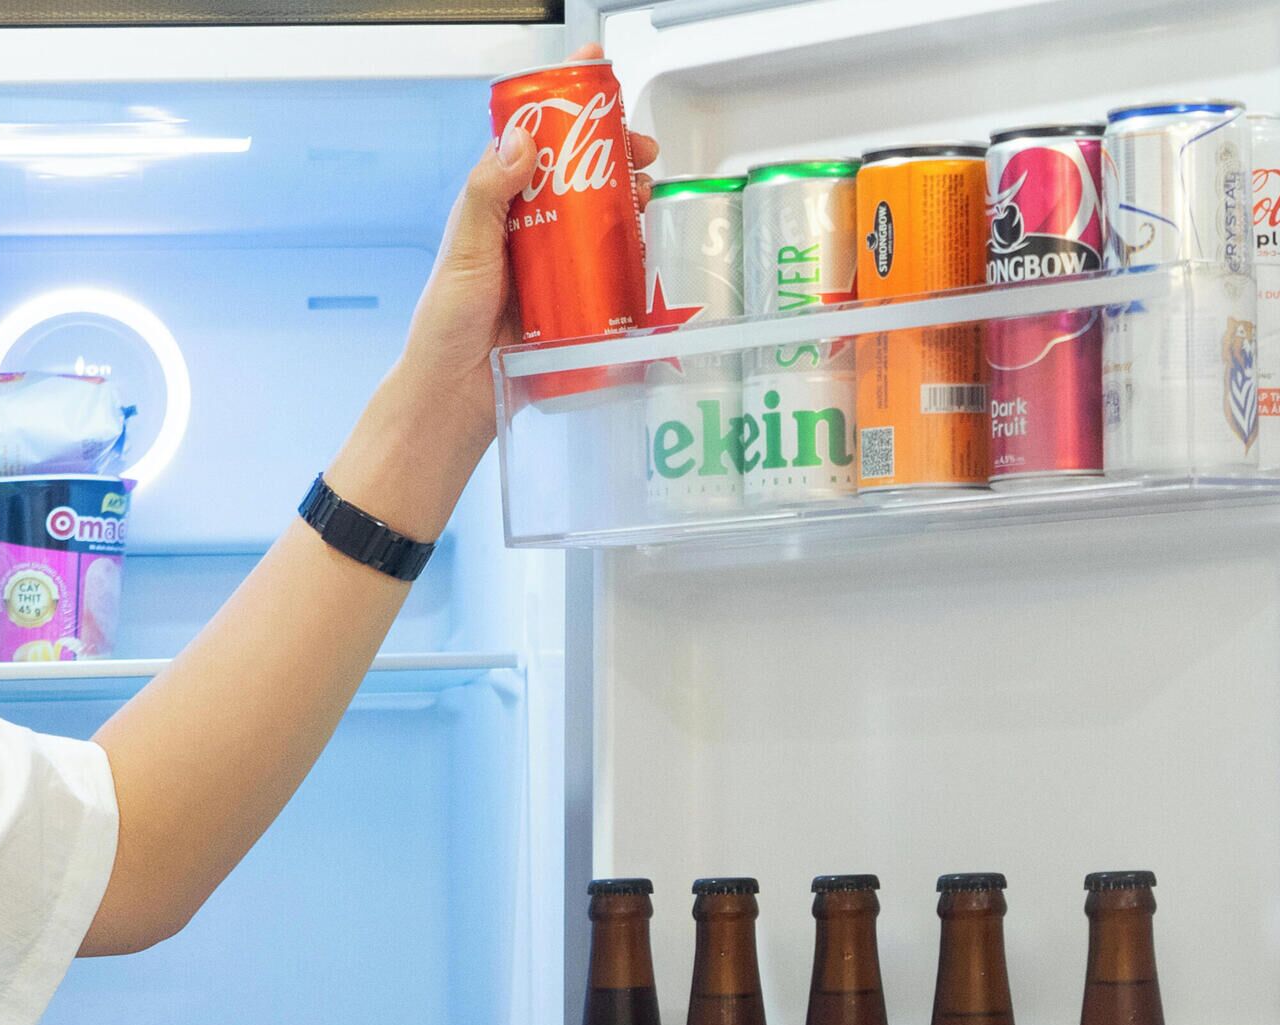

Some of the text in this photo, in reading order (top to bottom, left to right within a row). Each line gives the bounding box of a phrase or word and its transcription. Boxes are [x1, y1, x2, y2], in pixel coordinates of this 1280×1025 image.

[524, 208, 558, 228] BẢN
[1224, 172, 1241, 273] CRYSTAL
[878, 205, 889, 273] STRONGBOW
[986, 252, 1087, 285] ONGBOW
[776, 243, 820, 368] SVER
[991, 398, 1027, 418] Dark
[991, 417, 1026, 438] Fruit
[47, 507, 125, 541] Omac
